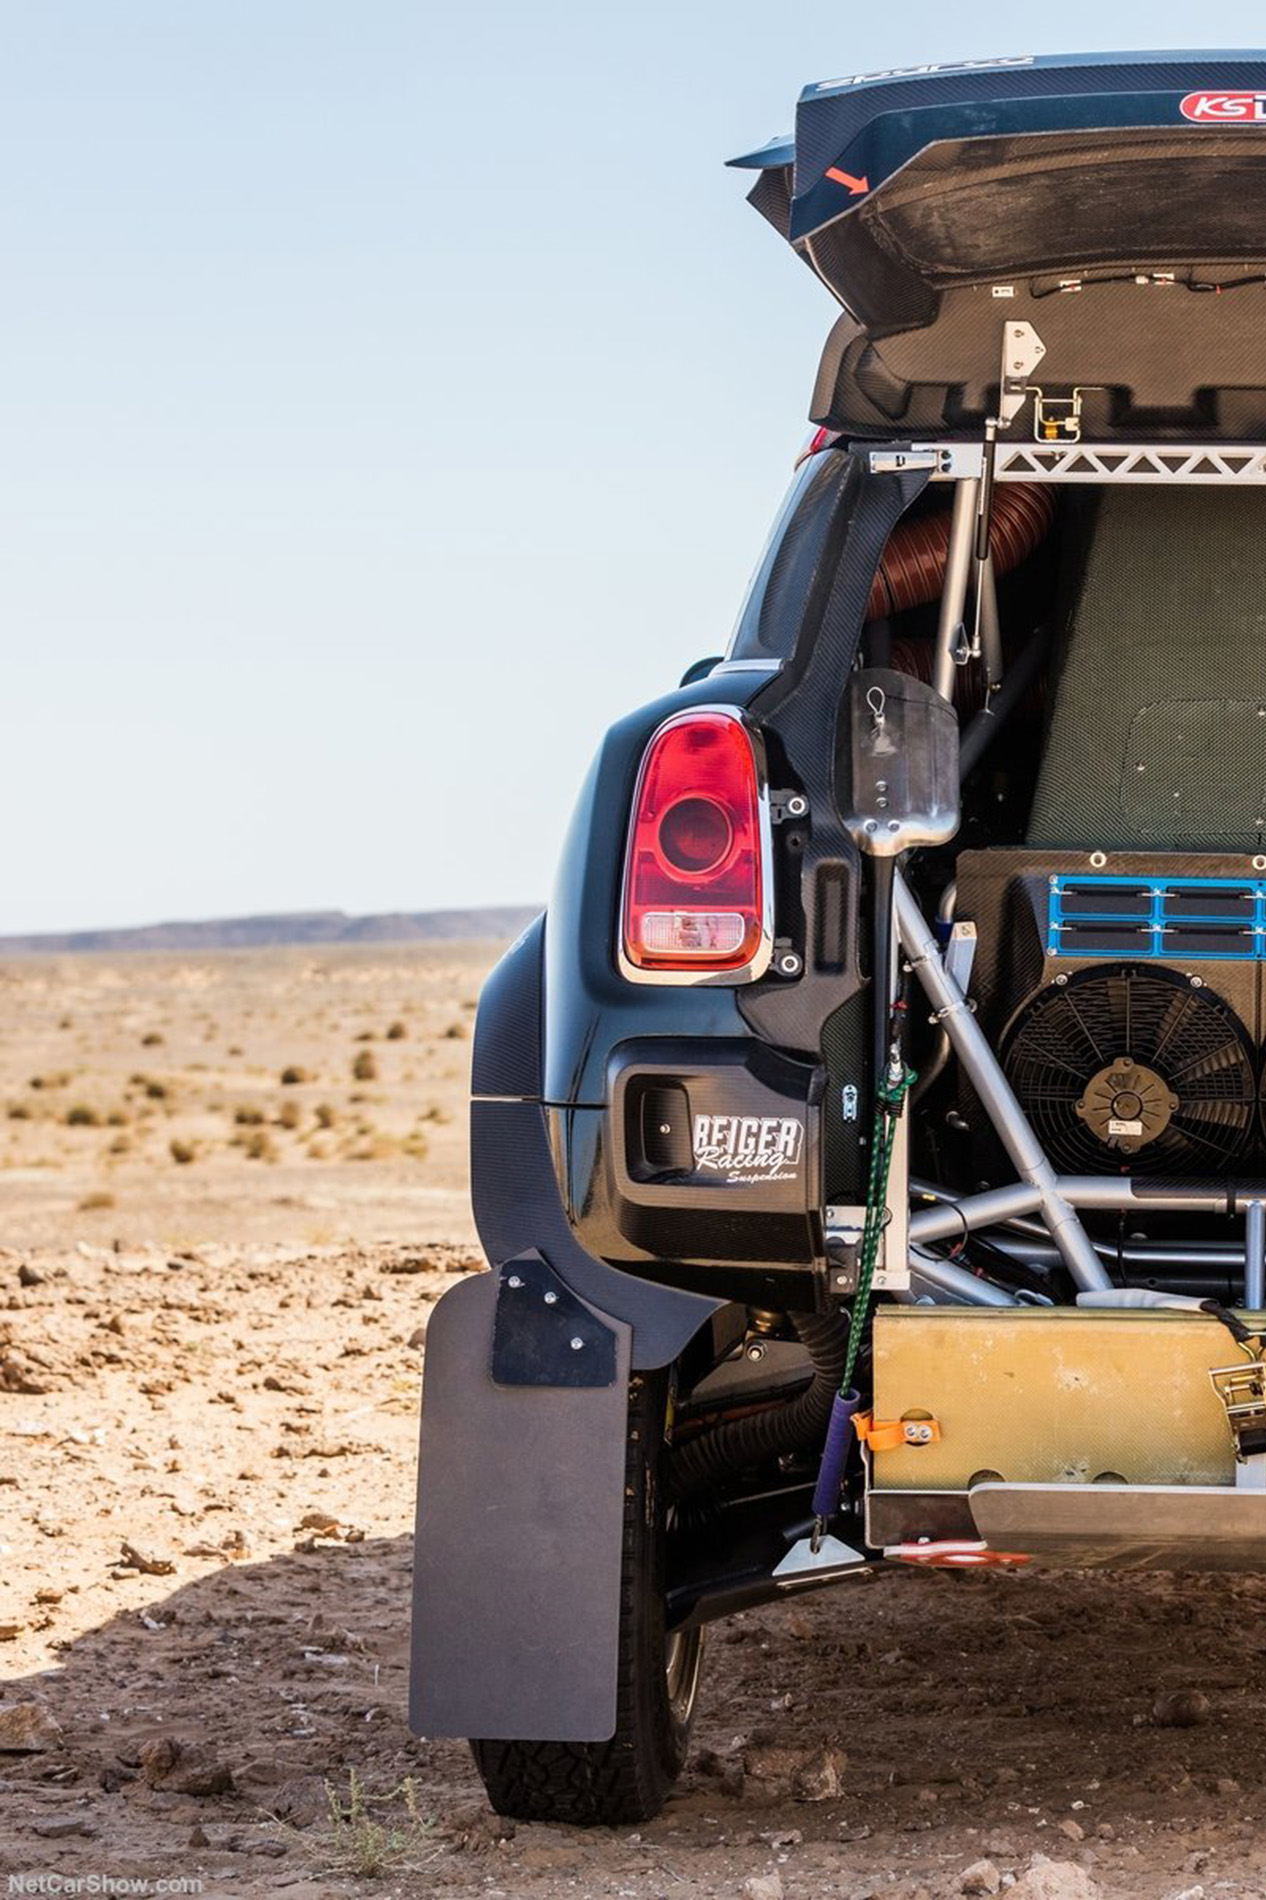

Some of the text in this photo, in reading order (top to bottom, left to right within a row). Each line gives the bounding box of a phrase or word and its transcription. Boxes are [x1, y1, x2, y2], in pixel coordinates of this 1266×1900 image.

[694, 1114, 802, 1157] REIGER
[694, 1145, 788, 1174] Racing
[726, 1170, 798, 1184] Suspension
